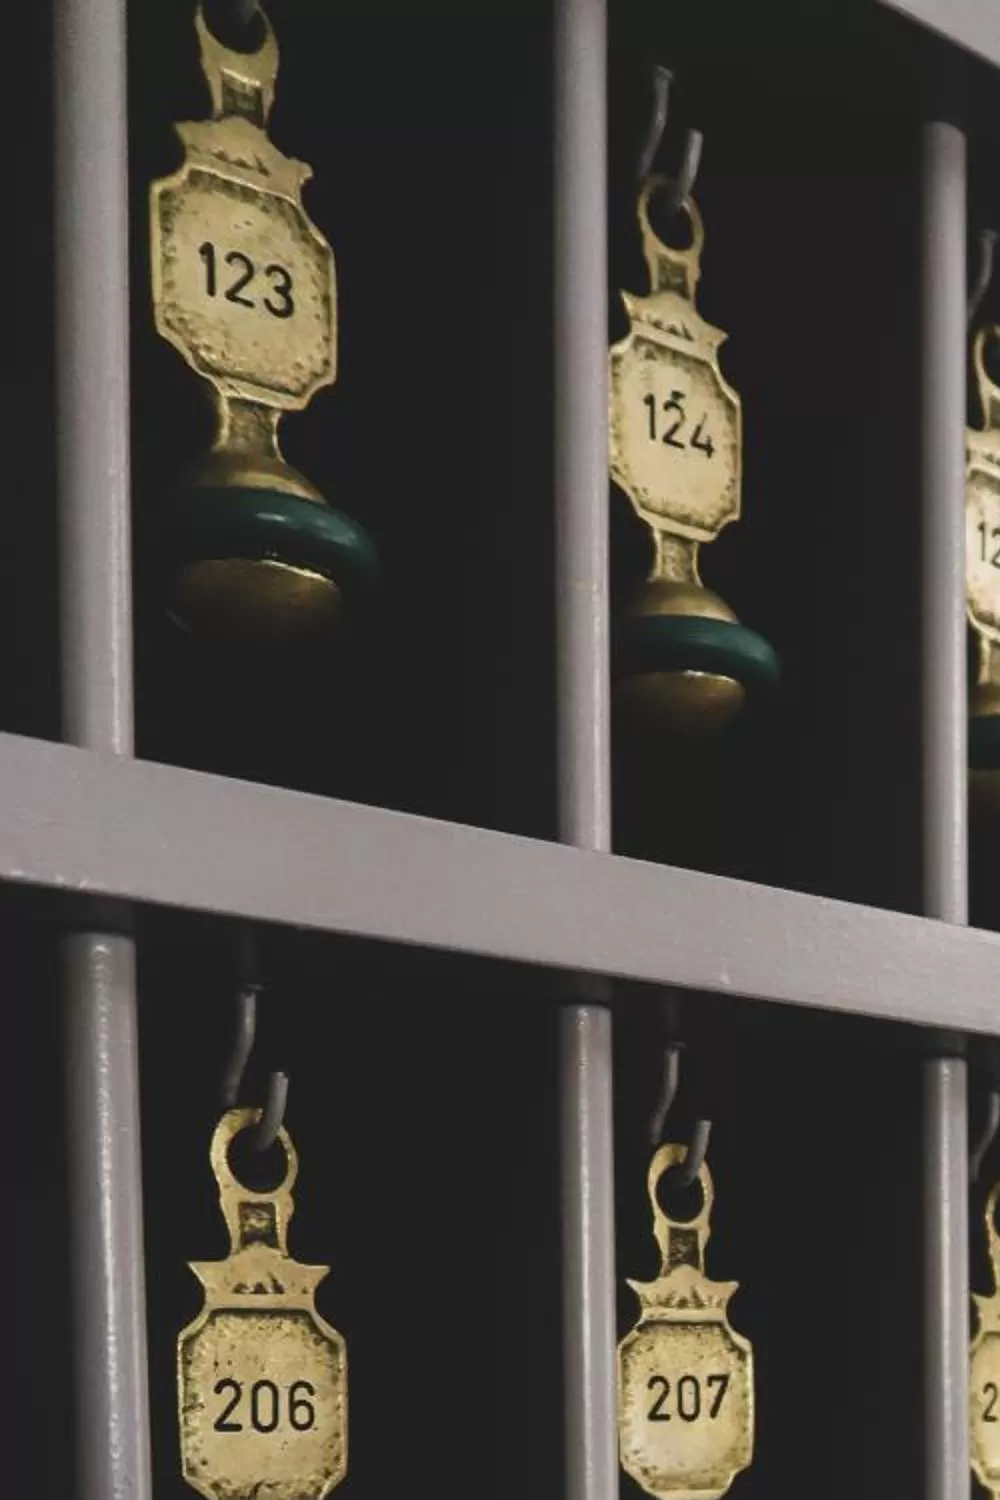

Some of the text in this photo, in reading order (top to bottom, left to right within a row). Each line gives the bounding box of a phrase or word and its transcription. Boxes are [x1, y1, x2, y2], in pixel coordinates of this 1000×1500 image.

[197, 241, 296, 319] 123
[640, 392, 717, 460] 124
[213, 1377, 316, 1433] 206
[646, 1373, 731, 1423] 207
